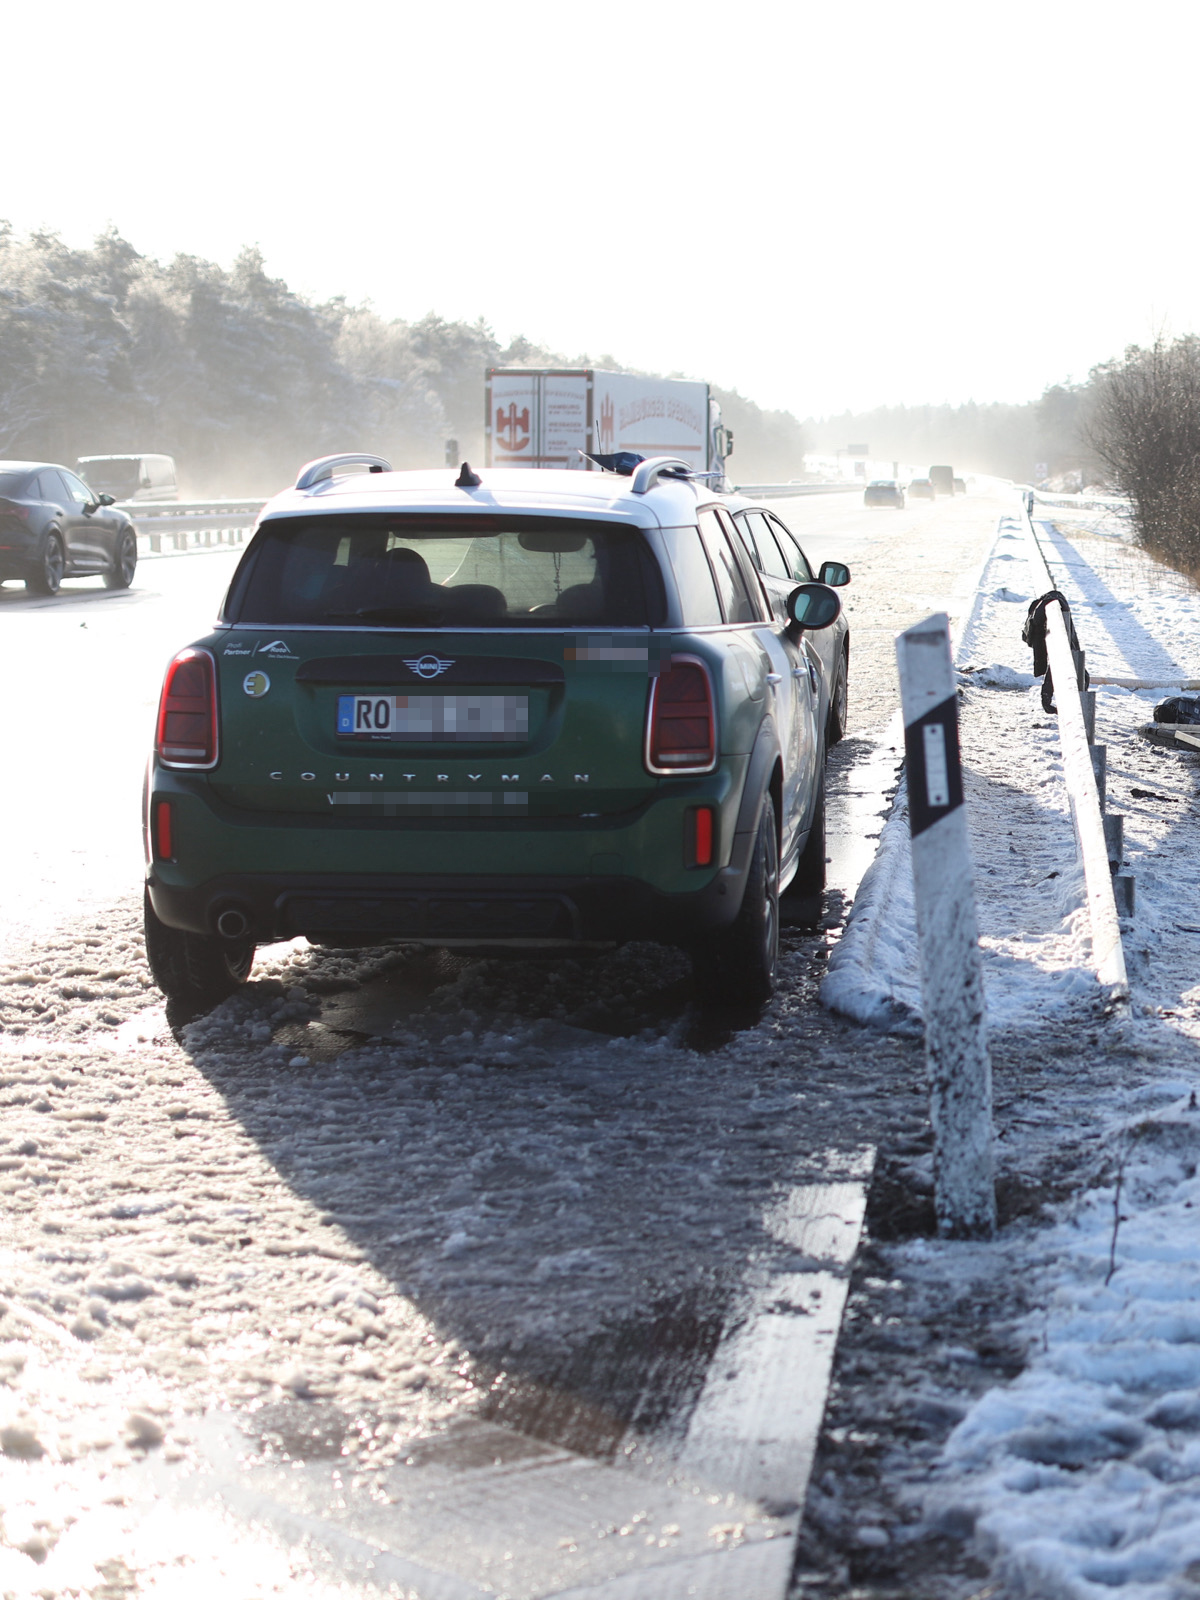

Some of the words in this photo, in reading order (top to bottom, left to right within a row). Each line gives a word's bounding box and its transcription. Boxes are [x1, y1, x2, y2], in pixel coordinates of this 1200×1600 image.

[356, 699, 391, 729] RO
[342, 718, 349, 727] D
[269, 770, 590, 784] COUNTRYMAN
